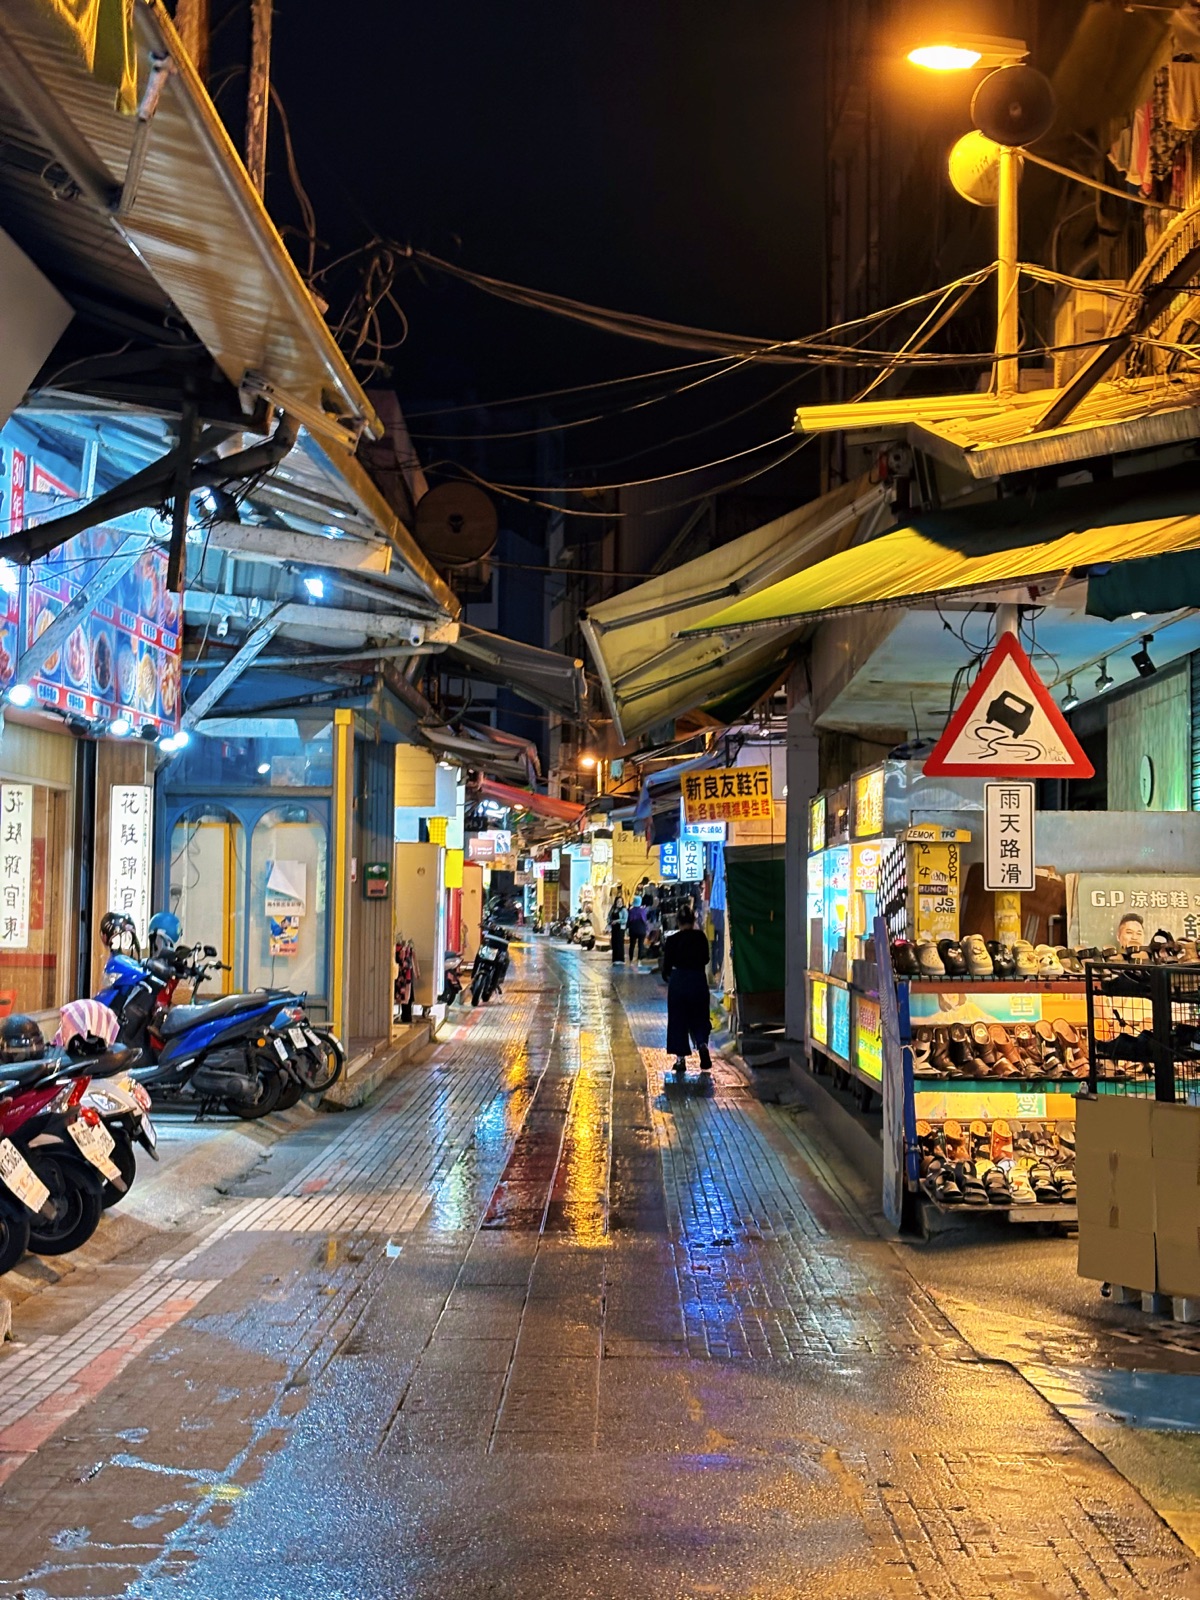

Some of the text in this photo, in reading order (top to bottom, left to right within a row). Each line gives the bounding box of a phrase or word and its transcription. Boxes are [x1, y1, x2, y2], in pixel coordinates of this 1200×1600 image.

[685, 771, 769, 801] 新良友鞋行
[908, 830, 935, 839] ZEMOK
[999, 789, 1022, 884] 雨天路滑
[119, 792, 141, 925] 花駐錦官
[937, 898, 954, 906] JS
[1091, 890, 1189, 908] G.P 涼拖鞋
